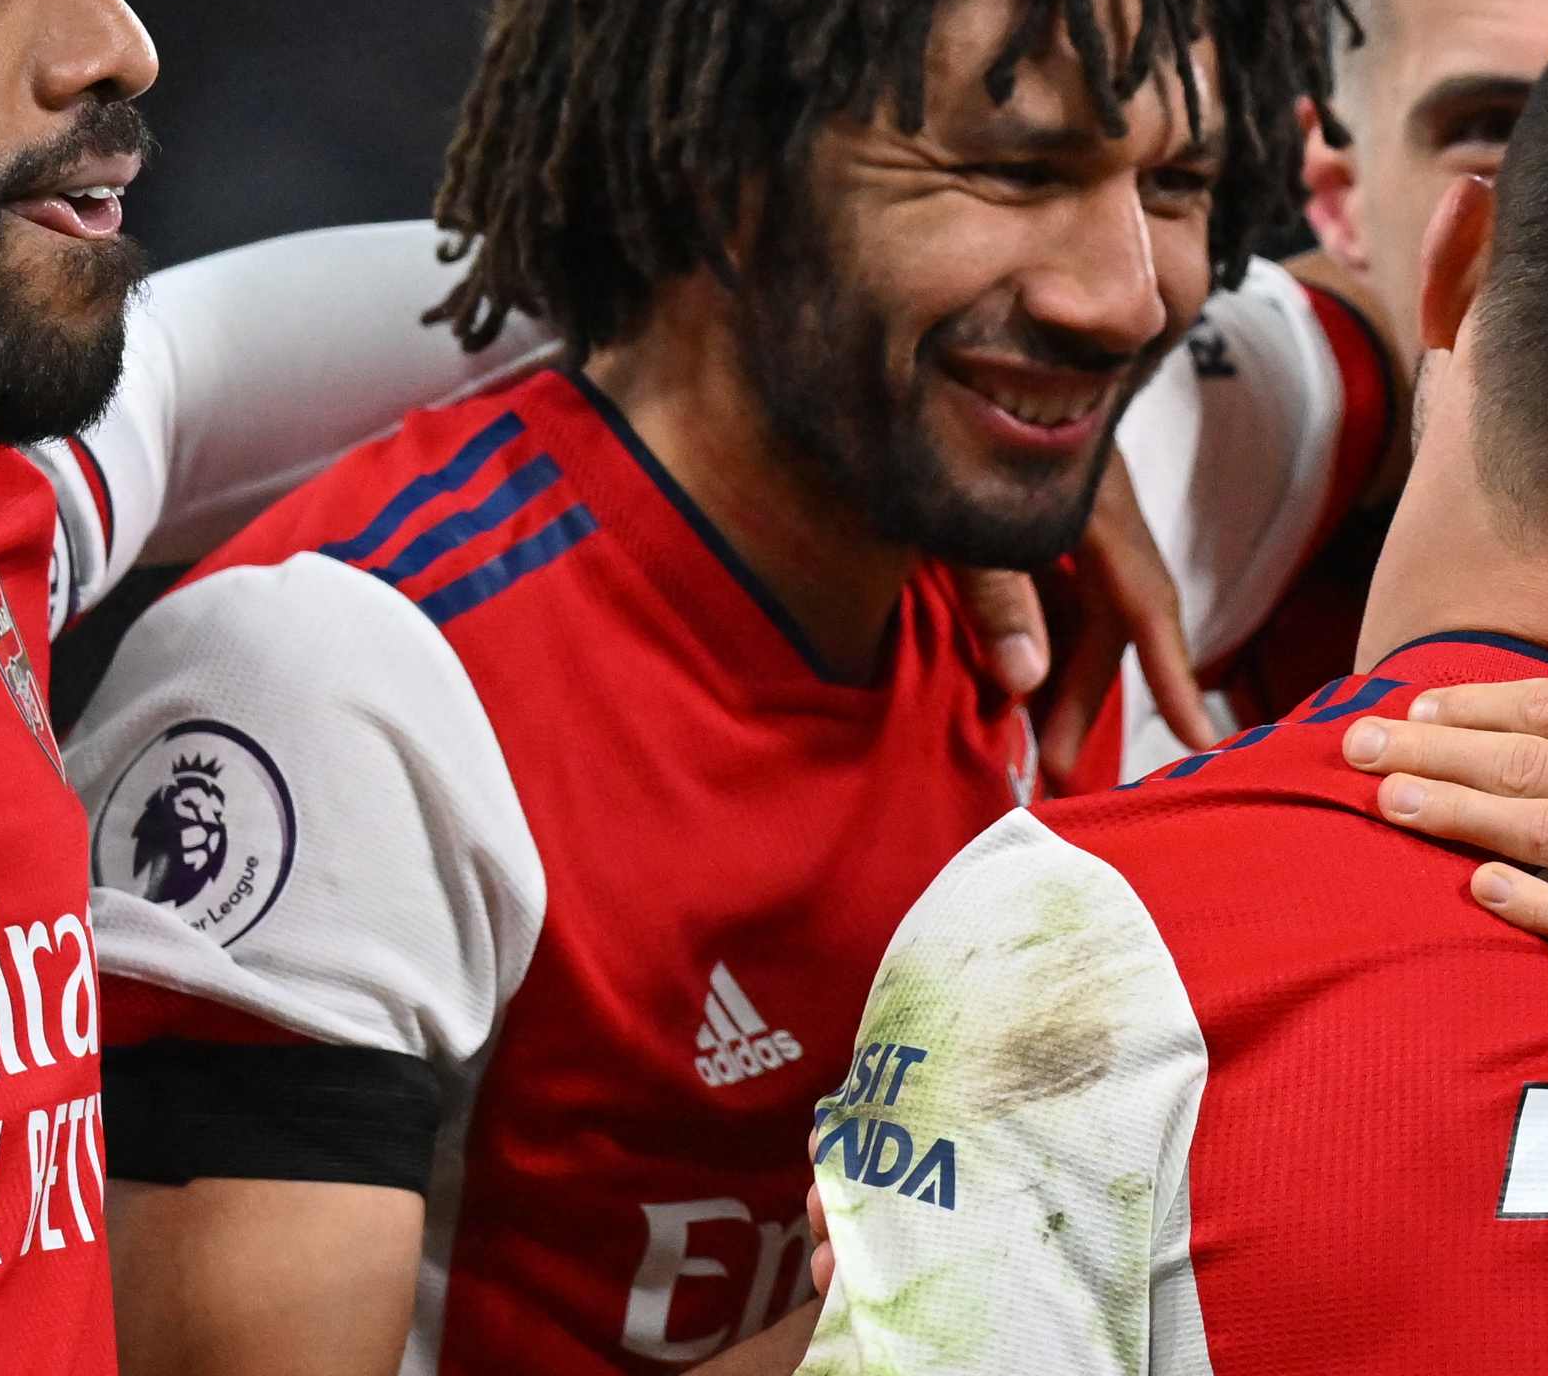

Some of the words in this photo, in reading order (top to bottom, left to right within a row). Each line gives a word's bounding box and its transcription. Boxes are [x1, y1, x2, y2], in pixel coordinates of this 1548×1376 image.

[207, 855, 259, 924] League
[694, 1029, 803, 1087] adidas
[824, 1042, 929, 1108] ISIT
[19, 1092, 103, 1257] BETT
